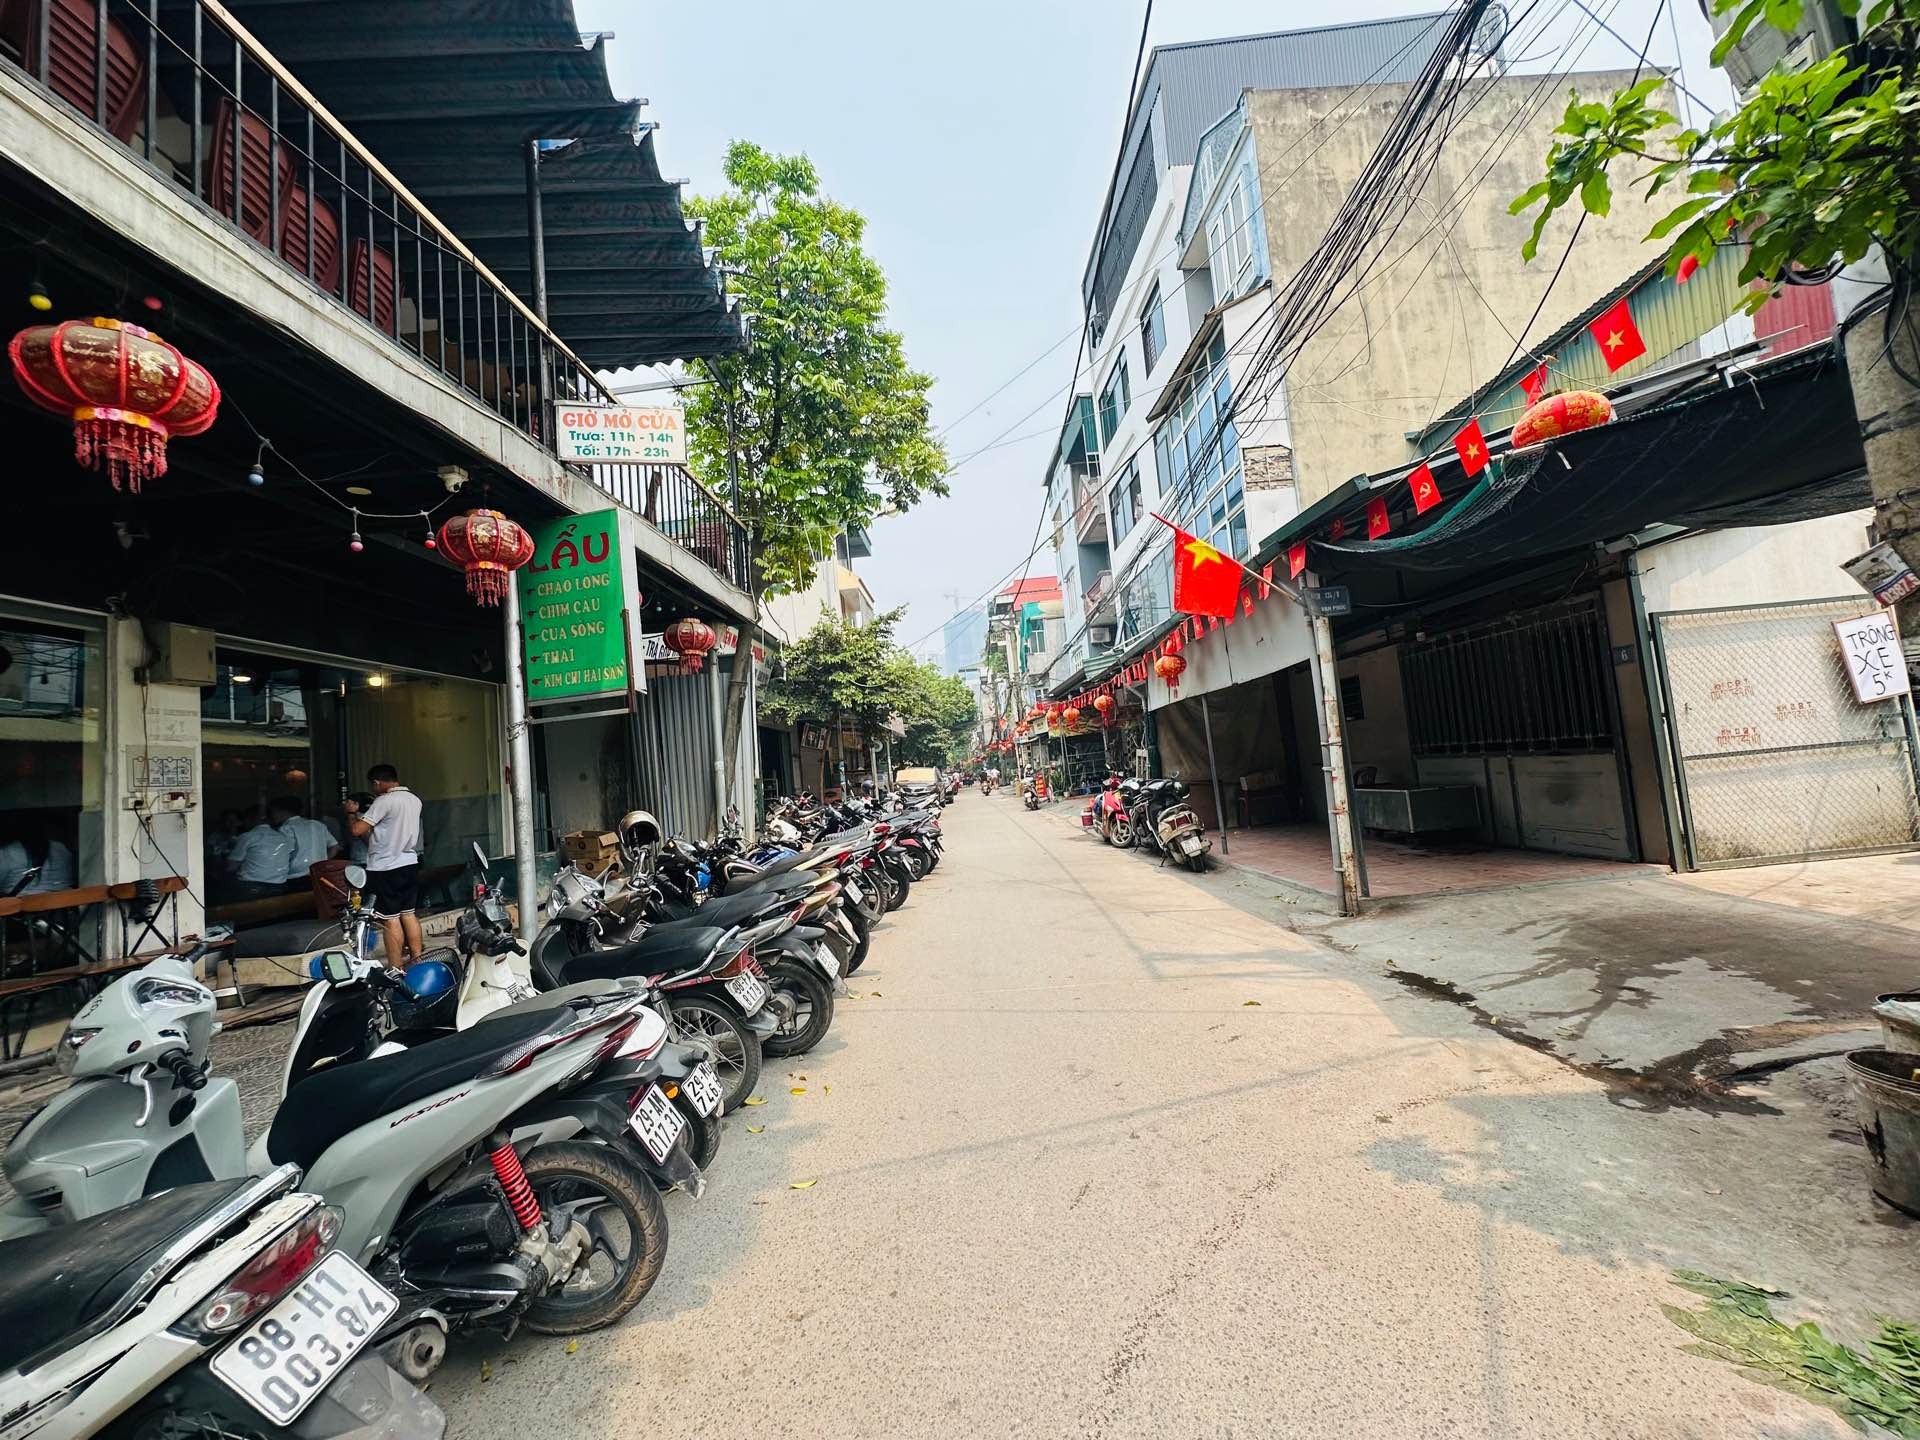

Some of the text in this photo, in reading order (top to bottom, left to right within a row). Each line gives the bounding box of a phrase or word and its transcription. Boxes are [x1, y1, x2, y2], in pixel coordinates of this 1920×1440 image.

[562, 409, 678, 429] GIỜ MỞ CỬA
[569, 430, 604, 441] Trưa:
[610, 432, 635, 442] 11h
[649, 433, 673, 442] 14h
[574, 444, 600, 455] Tối:
[606, 446, 631, 456] 17h
[644, 447, 669, 457] 23h
[539, 602, 570, 619] CHIM
[541, 627, 567, 642] CUA
[1846, 624, 1895, 649] TRÔNG
[1853, 647, 1894, 675] XE
[544, 672, 562, 688] KIM
[565, 670, 581, 685] CHI
[390, 1089, 472, 1128] VISION
[635, 1089, 667, 1135] 29-AM
[649, 1106, 683, 1158] 017.31
[238, 1269, 348, 1370] 88-H1
[261, 1288, 387, 1413] 003.84
